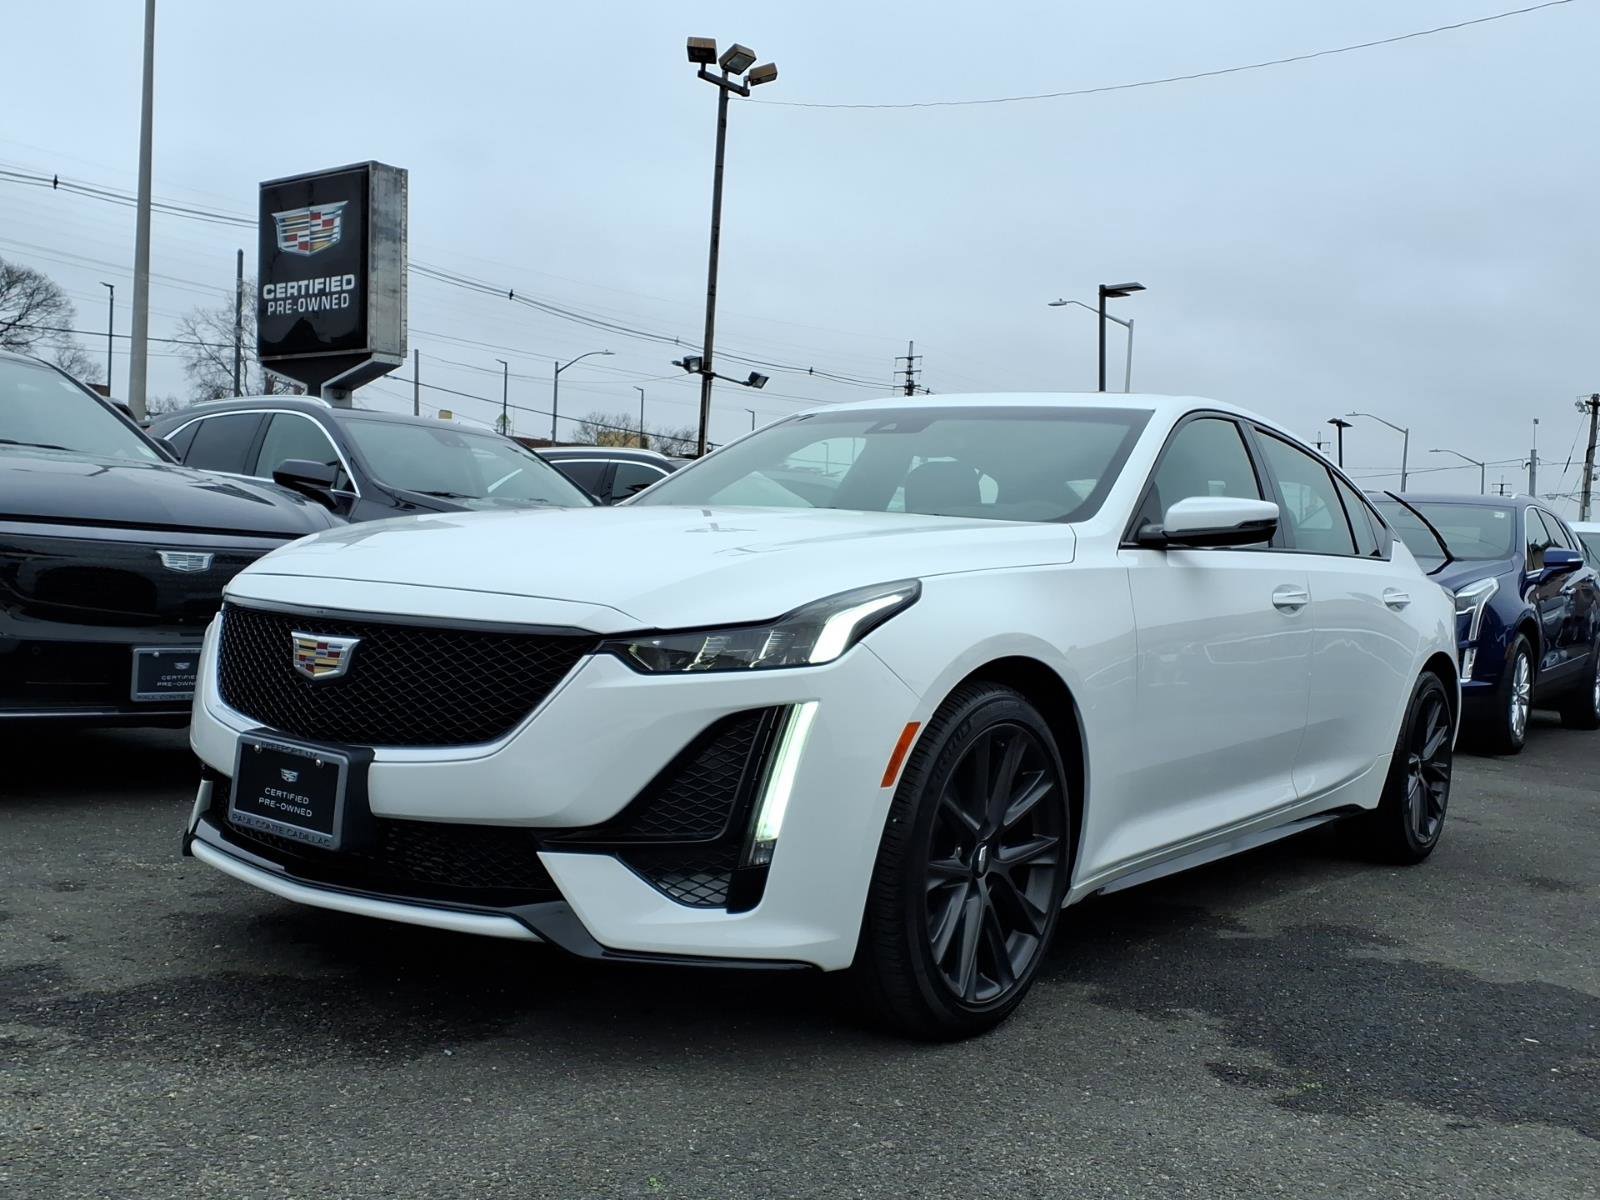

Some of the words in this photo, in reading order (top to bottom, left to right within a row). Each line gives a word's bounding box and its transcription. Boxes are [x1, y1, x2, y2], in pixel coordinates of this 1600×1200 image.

[262, 274, 356, 300] CERTIFIED
[267, 292, 350, 316] PRE-OWNED
[258, 797, 313, 817] PRE-OWNED
[264, 787, 310, 805] CERTIFIED
[232, 813, 252, 826] PAUL
[287, 828, 331, 847] CADILLAC
